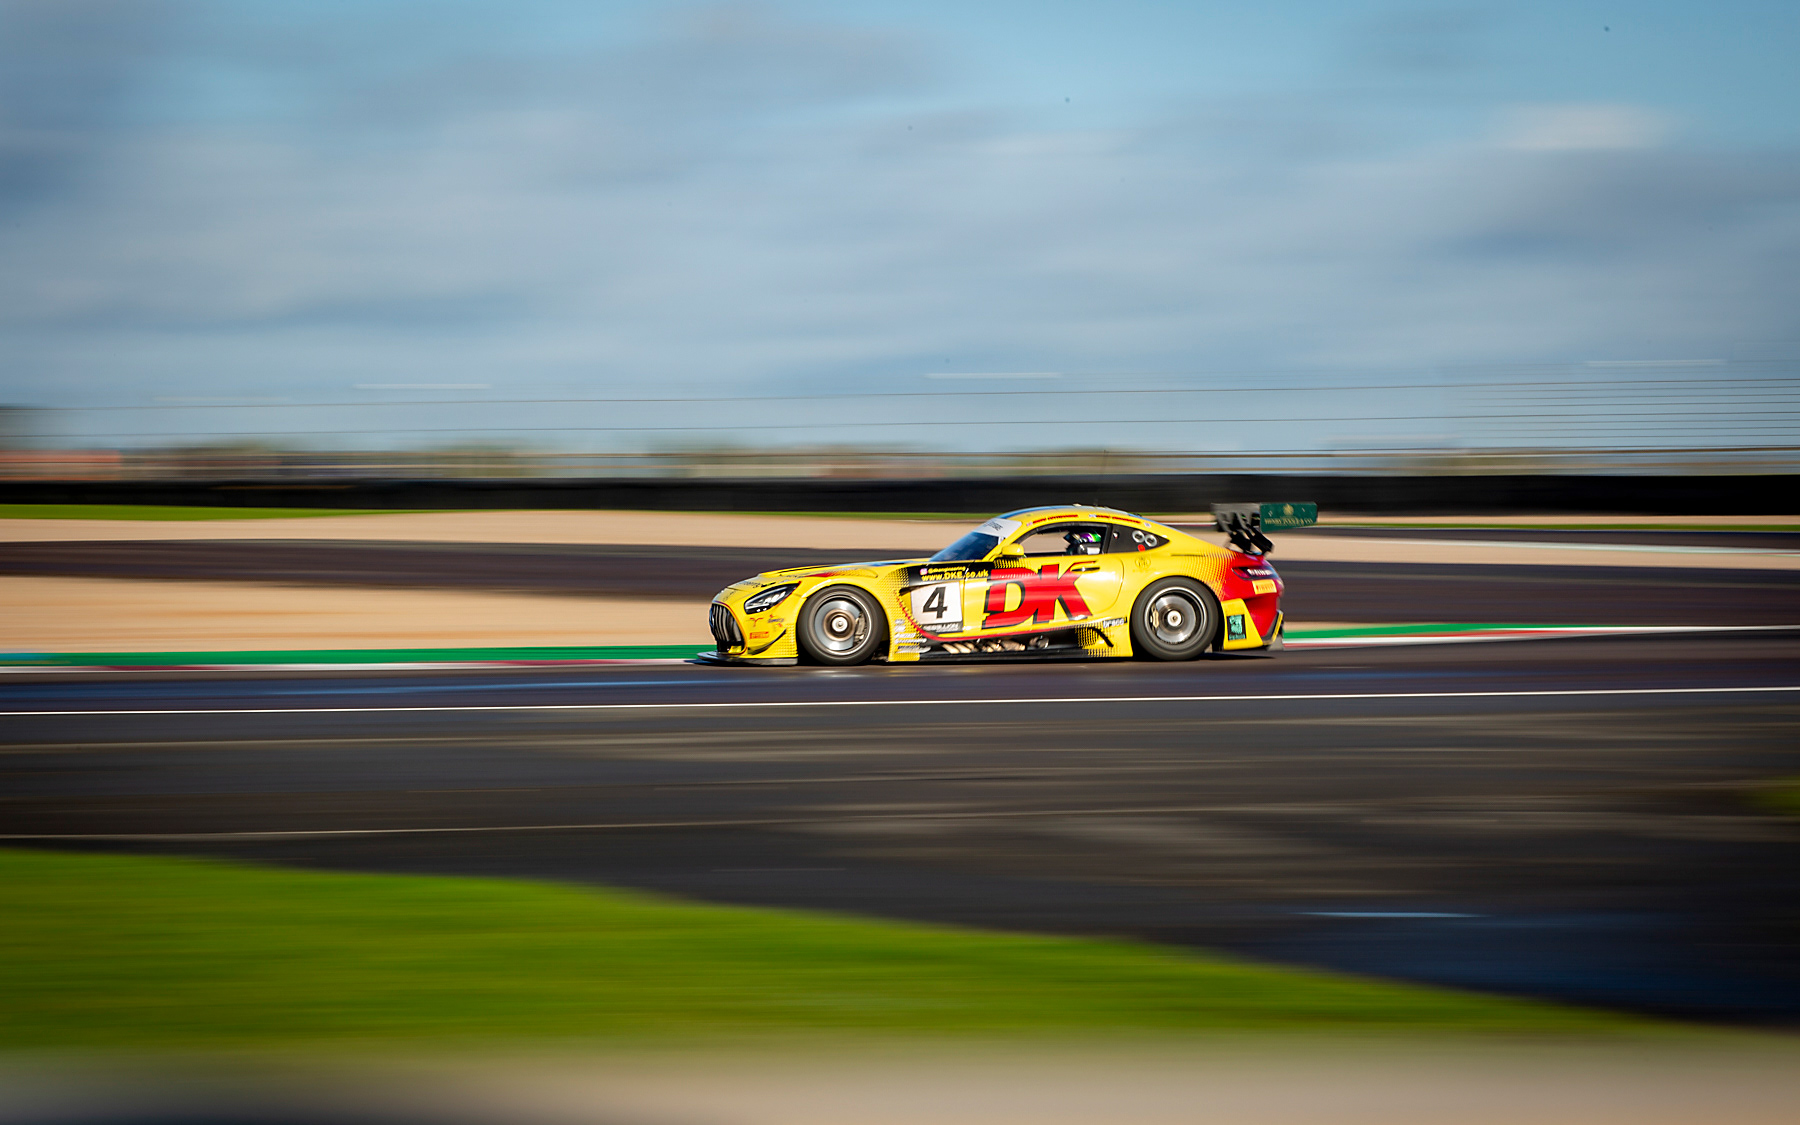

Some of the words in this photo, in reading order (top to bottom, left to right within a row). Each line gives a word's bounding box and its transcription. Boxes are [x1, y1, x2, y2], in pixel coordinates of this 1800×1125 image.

[921, 569, 988, 581] www.DKE.co.uk
[922, 586, 948, 619] 4
[981, 561, 1096, 629] DK
